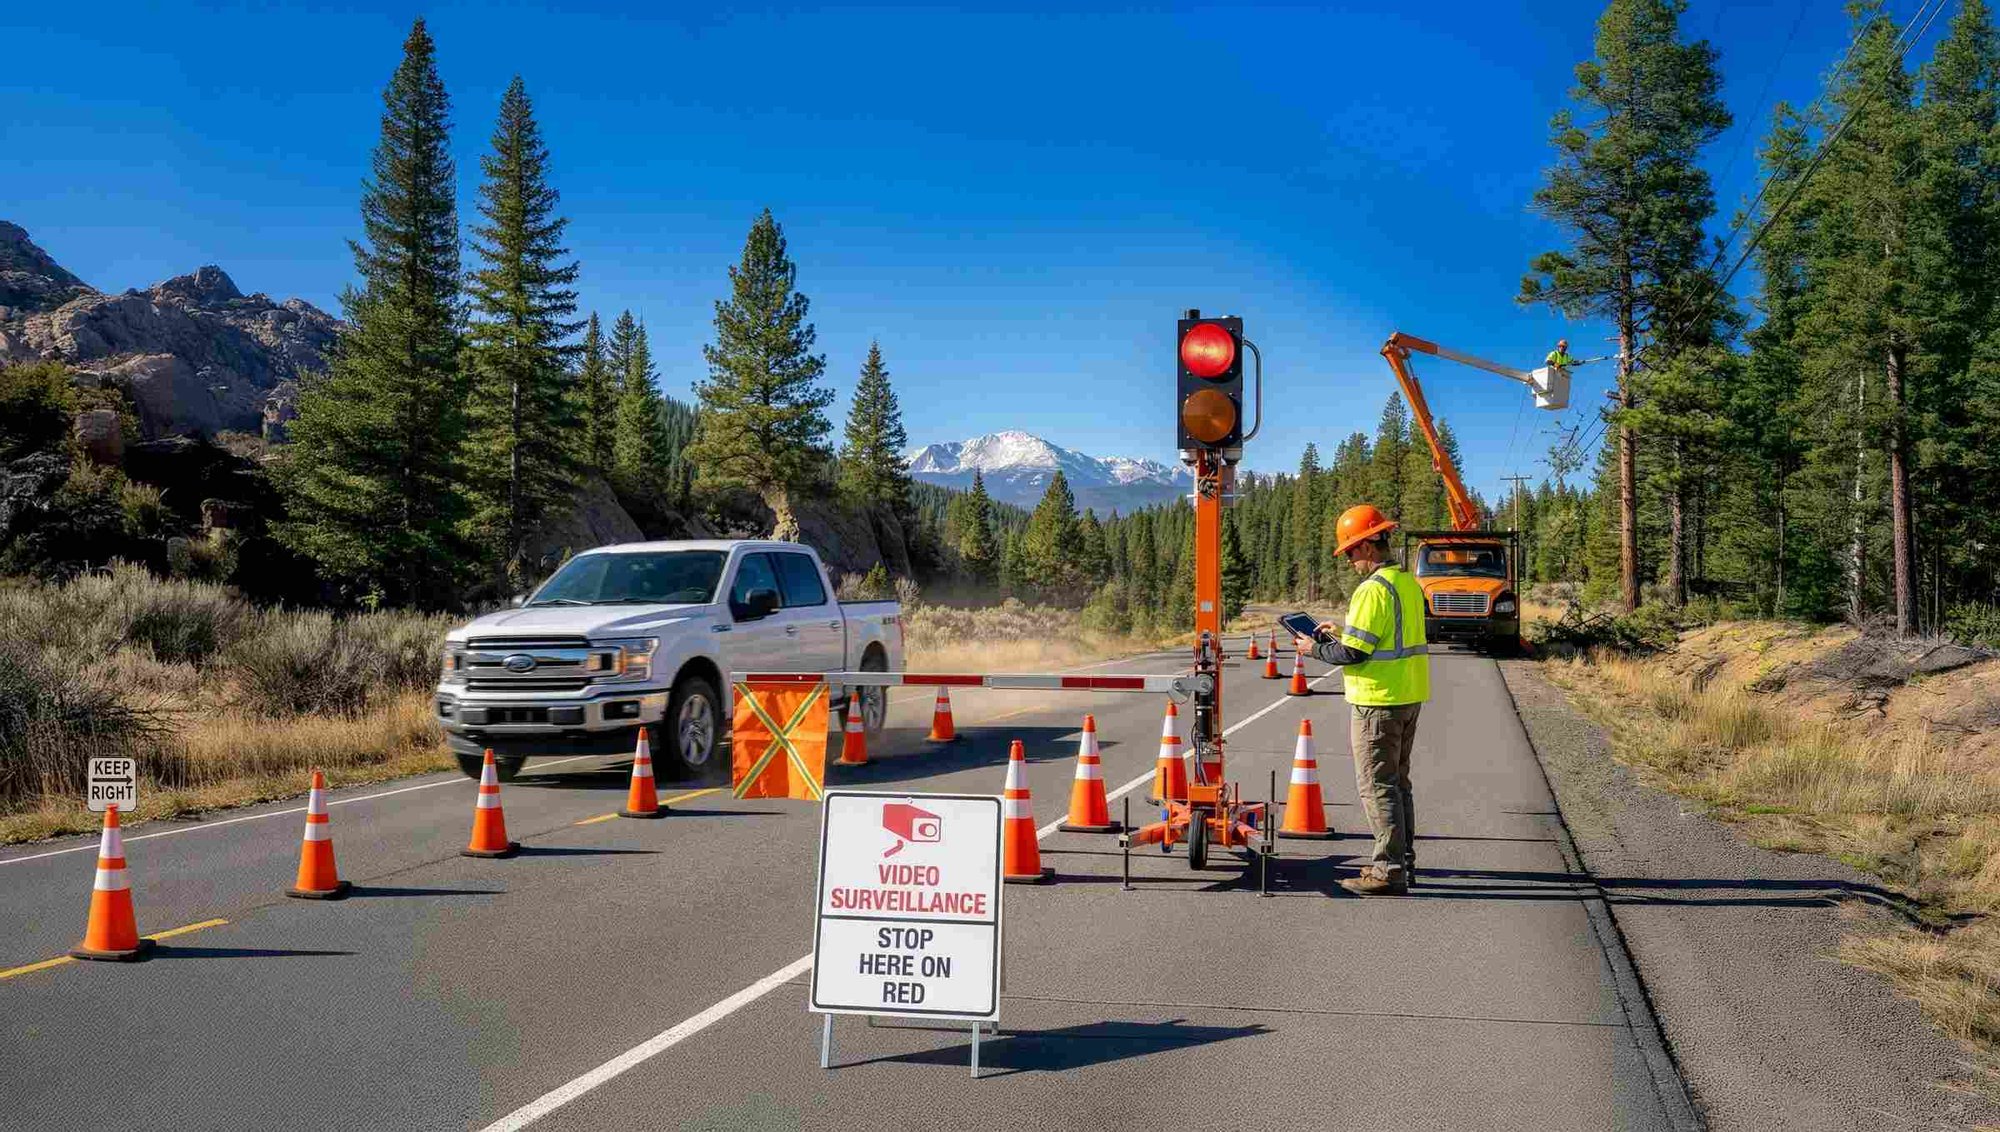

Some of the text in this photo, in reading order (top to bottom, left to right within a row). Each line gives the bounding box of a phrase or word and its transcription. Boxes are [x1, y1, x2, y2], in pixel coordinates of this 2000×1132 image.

[94, 760, 131, 775] KEEP
[91, 785, 133, 800] RIGHT
[878, 864, 940, 886] VIDEO
[830, 888, 987, 915] SURVEILLANCE
[877, 927, 934, 950] STOP
[859, 953, 952, 978] HERE ON
[882, 981, 926, 1004] RED
